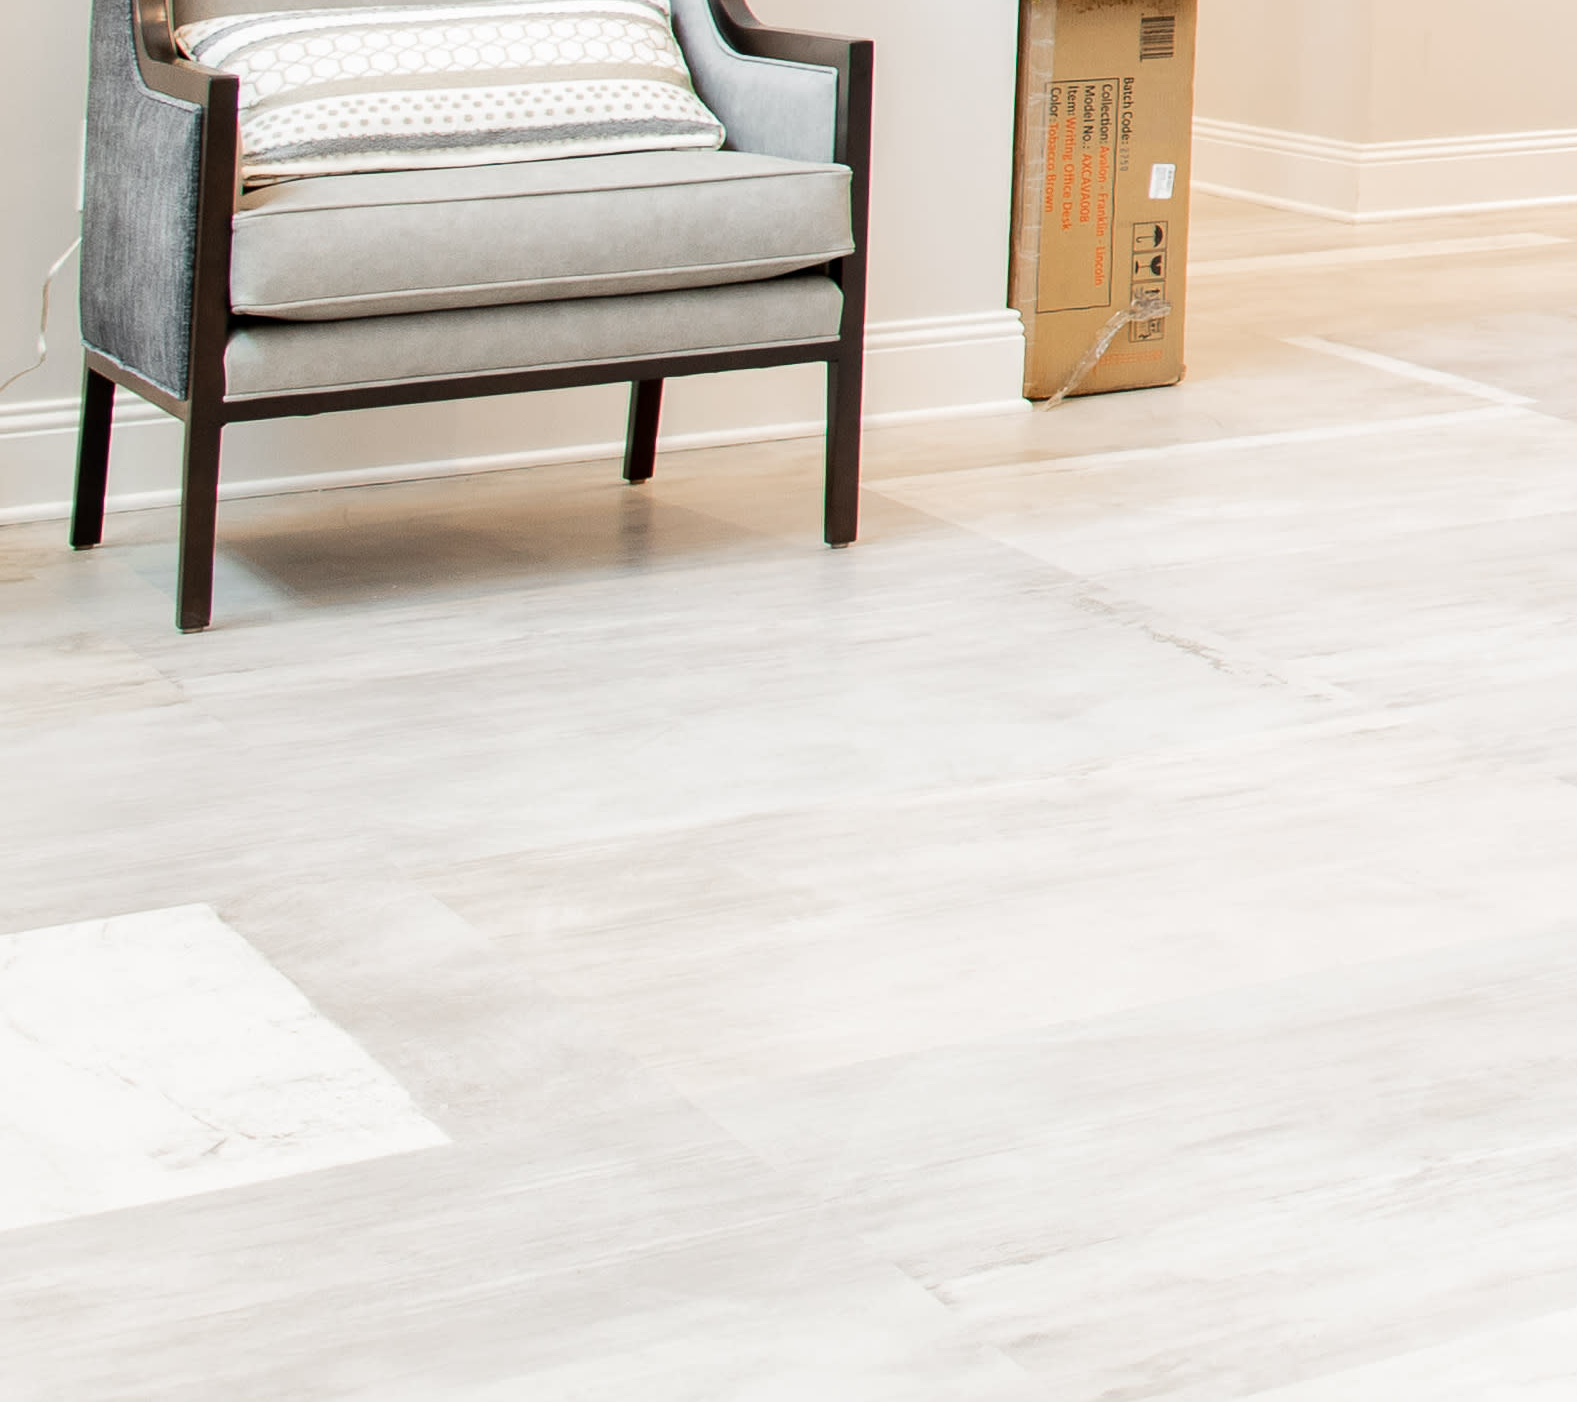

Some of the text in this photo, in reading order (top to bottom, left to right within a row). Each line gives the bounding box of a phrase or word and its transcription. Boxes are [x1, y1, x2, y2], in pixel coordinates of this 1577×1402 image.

[1083, 85, 1095, 122] Model
[1122, 77, 1134, 109] Batch
[1099, 84, 1113, 144] Collection:
[1121, 112, 1133, 144] Code:
[1046, 123, 1059, 170] Tobacco
[1082, 126, 1093, 149] No.:
[1061, 86, 1079, 231] Item: Writing Office Desk
[1098, 146, 1110, 183] Avalon
[1045, 174, 1058, 212] Brown
[1096, 193, 1108, 237] Franklin
[1094, 246, 1106, 286] Lincoln
